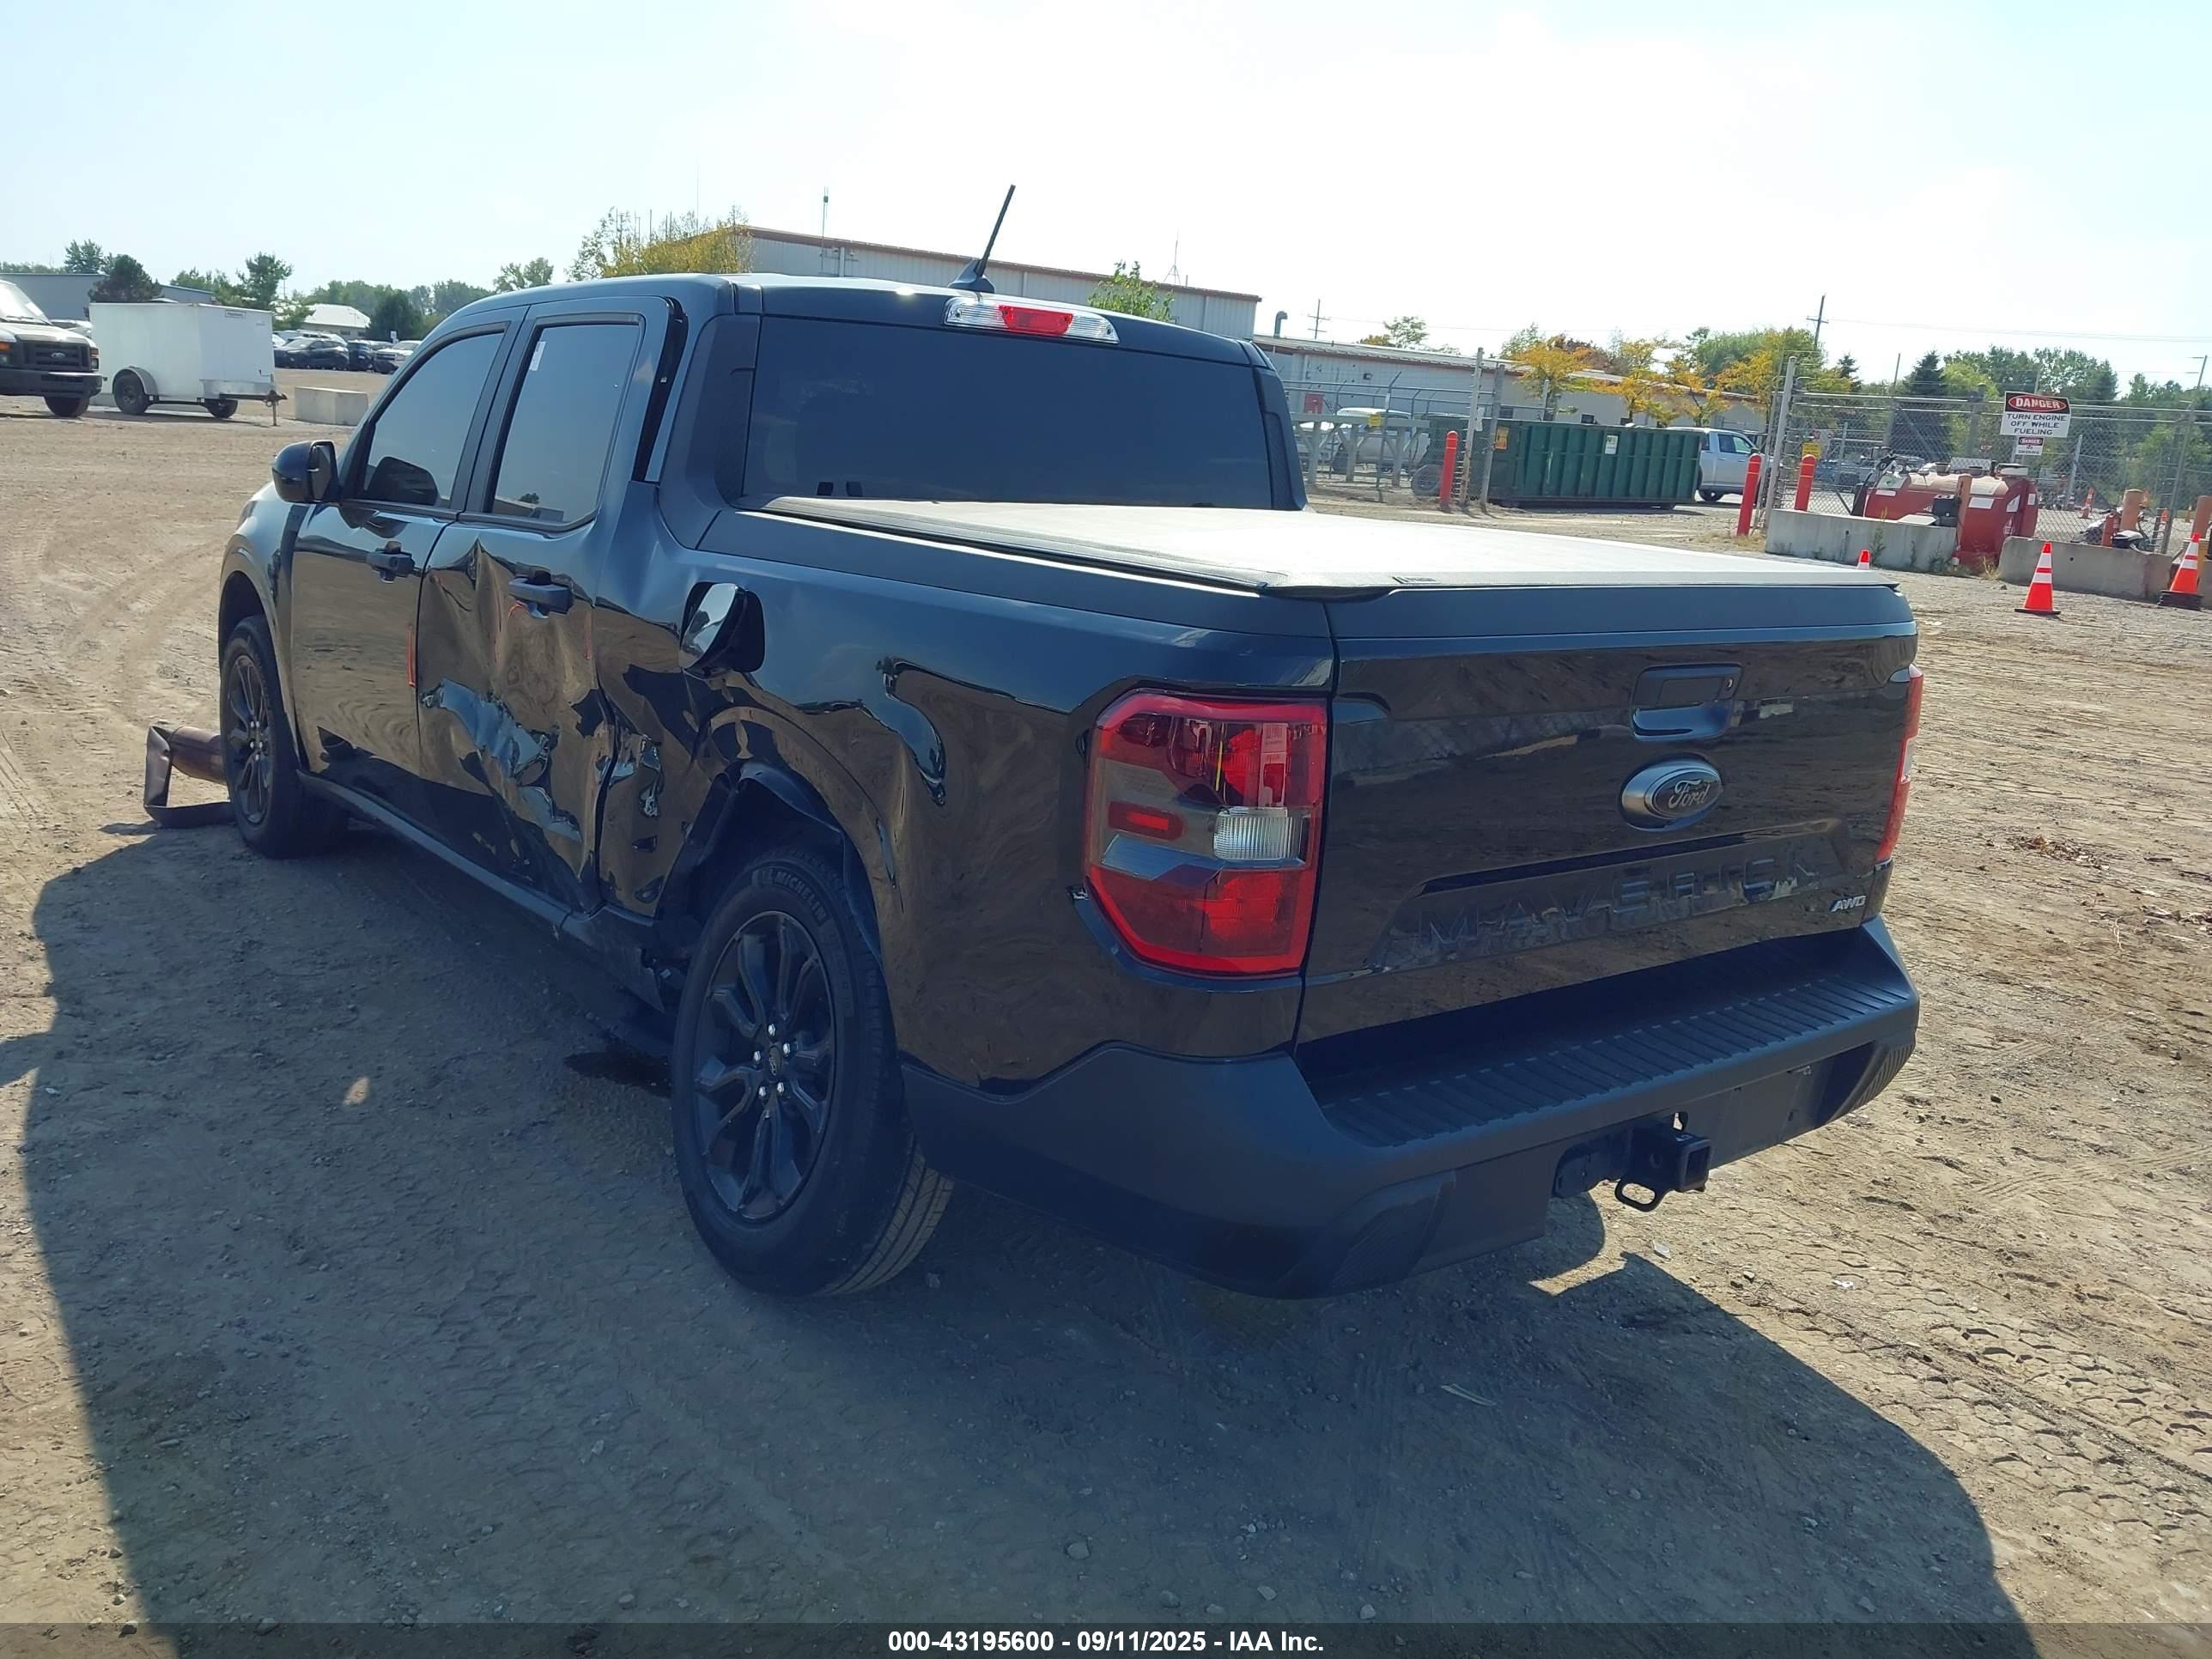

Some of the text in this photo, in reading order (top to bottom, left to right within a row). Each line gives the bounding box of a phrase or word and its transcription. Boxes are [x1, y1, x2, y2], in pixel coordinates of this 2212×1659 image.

[2015, 398, 2060, 409] DANGER
[1668, 779, 1711, 808] Ford
[775, 871, 827, 921] MICHELIN
[1831, 896, 1867, 913] AWD
